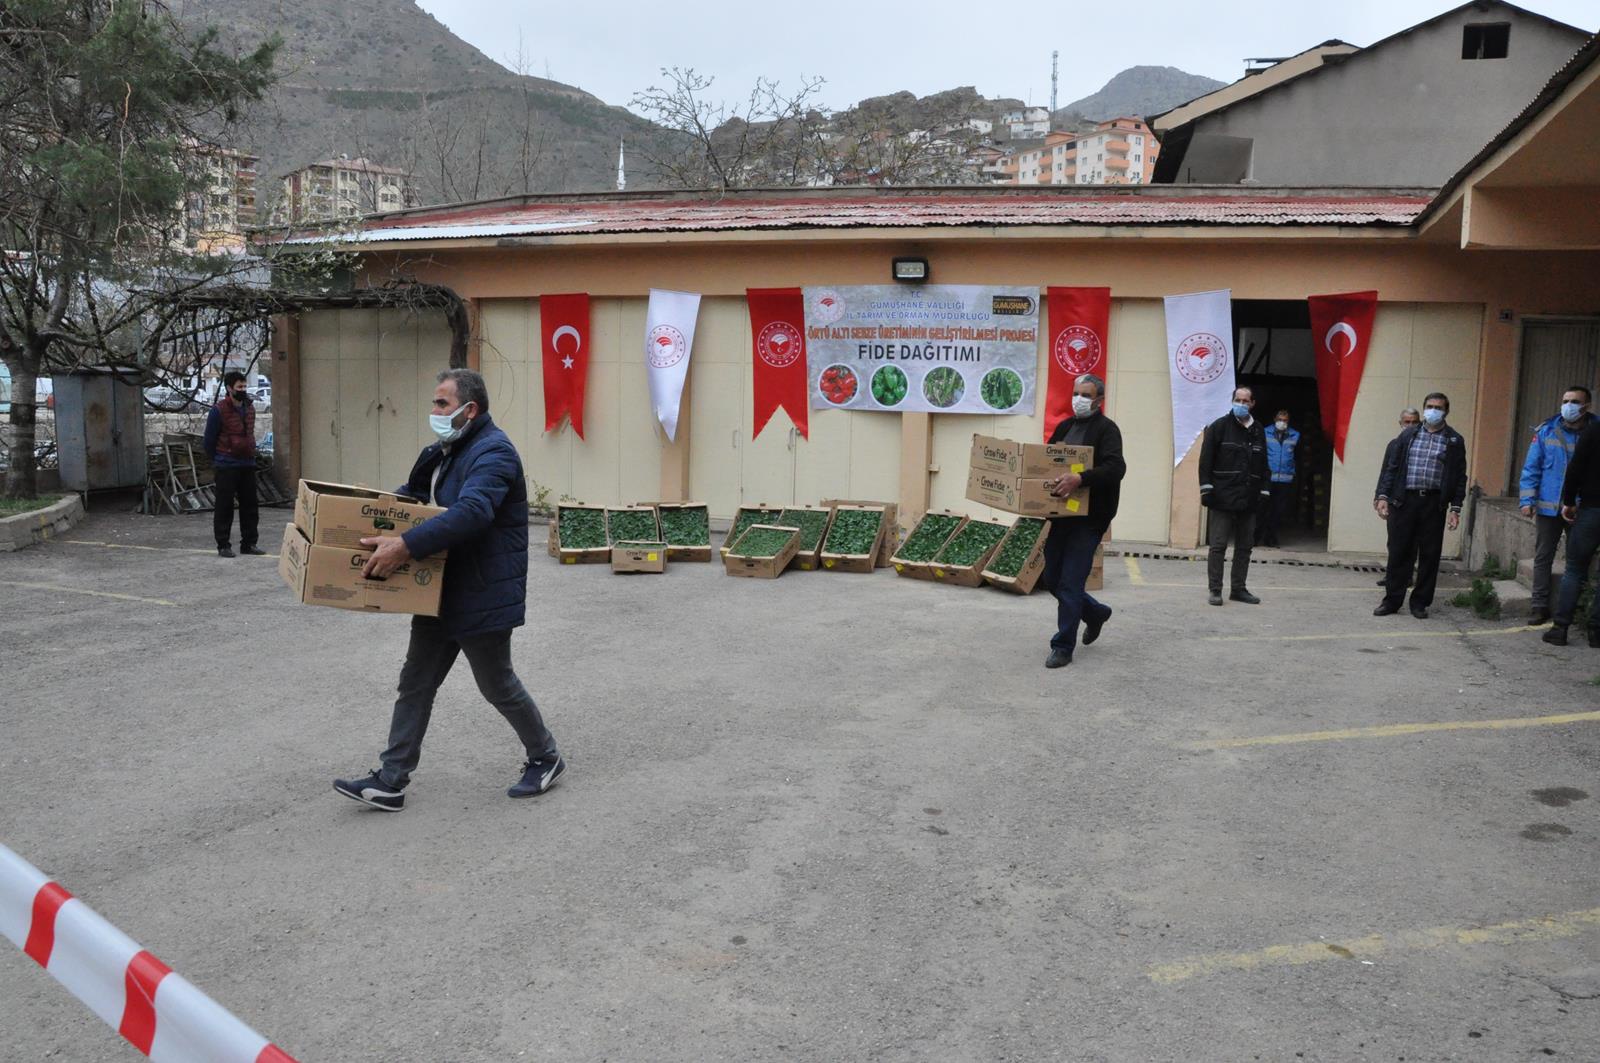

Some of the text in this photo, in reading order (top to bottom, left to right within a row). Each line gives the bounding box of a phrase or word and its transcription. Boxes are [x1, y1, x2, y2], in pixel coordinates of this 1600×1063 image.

[857, 311, 884, 320] TARIM
[885, 311, 897, 320] VE
[898, 311, 929, 321] ORMAN
[807, 324, 830, 340] ÖRTÜ
[831, 326, 850, 340] ALTI
[999, 327, 1036, 343] PROJESİ
[858, 340, 981, 362] FİDE DAĞITIMI
